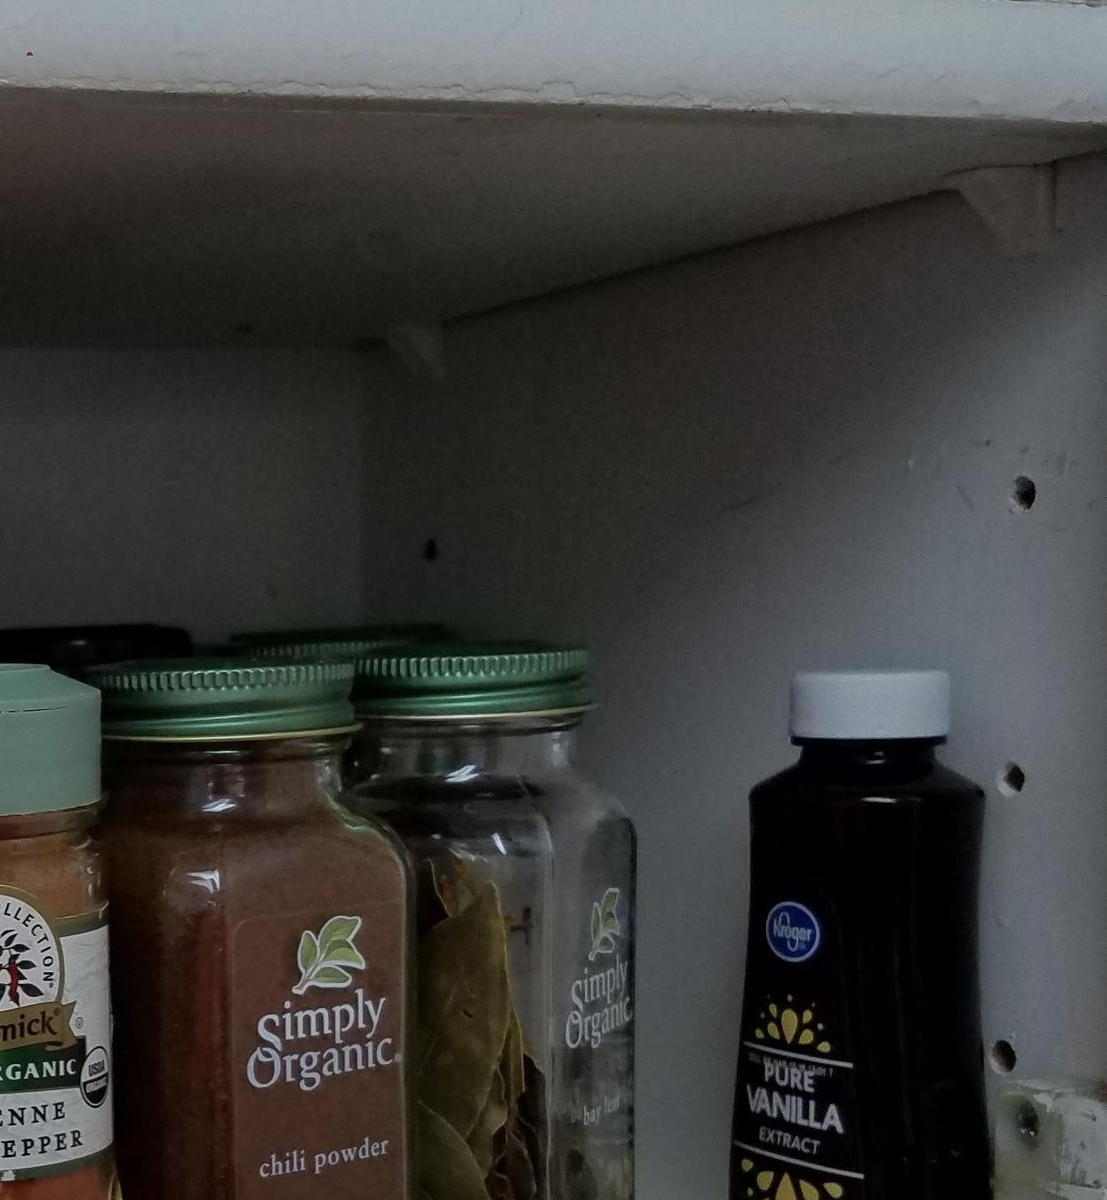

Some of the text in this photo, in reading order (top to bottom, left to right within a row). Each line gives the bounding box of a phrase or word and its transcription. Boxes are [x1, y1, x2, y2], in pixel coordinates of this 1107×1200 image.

[773, 911, 812, 952] Kroger
[572, 953, 628, 1013] Simply
[257, 988, 386, 1052] Simply
[565, 996, 632, 1049] Organic
[246, 1037, 393, 1091] Organic
[763, 1057, 815, 1093] PURE
[746, 1082, 844, 1134] VANILLA
[259, 1136, 389, 1178] chili powder
[759, 1125, 821, 1155] EXTRACT
